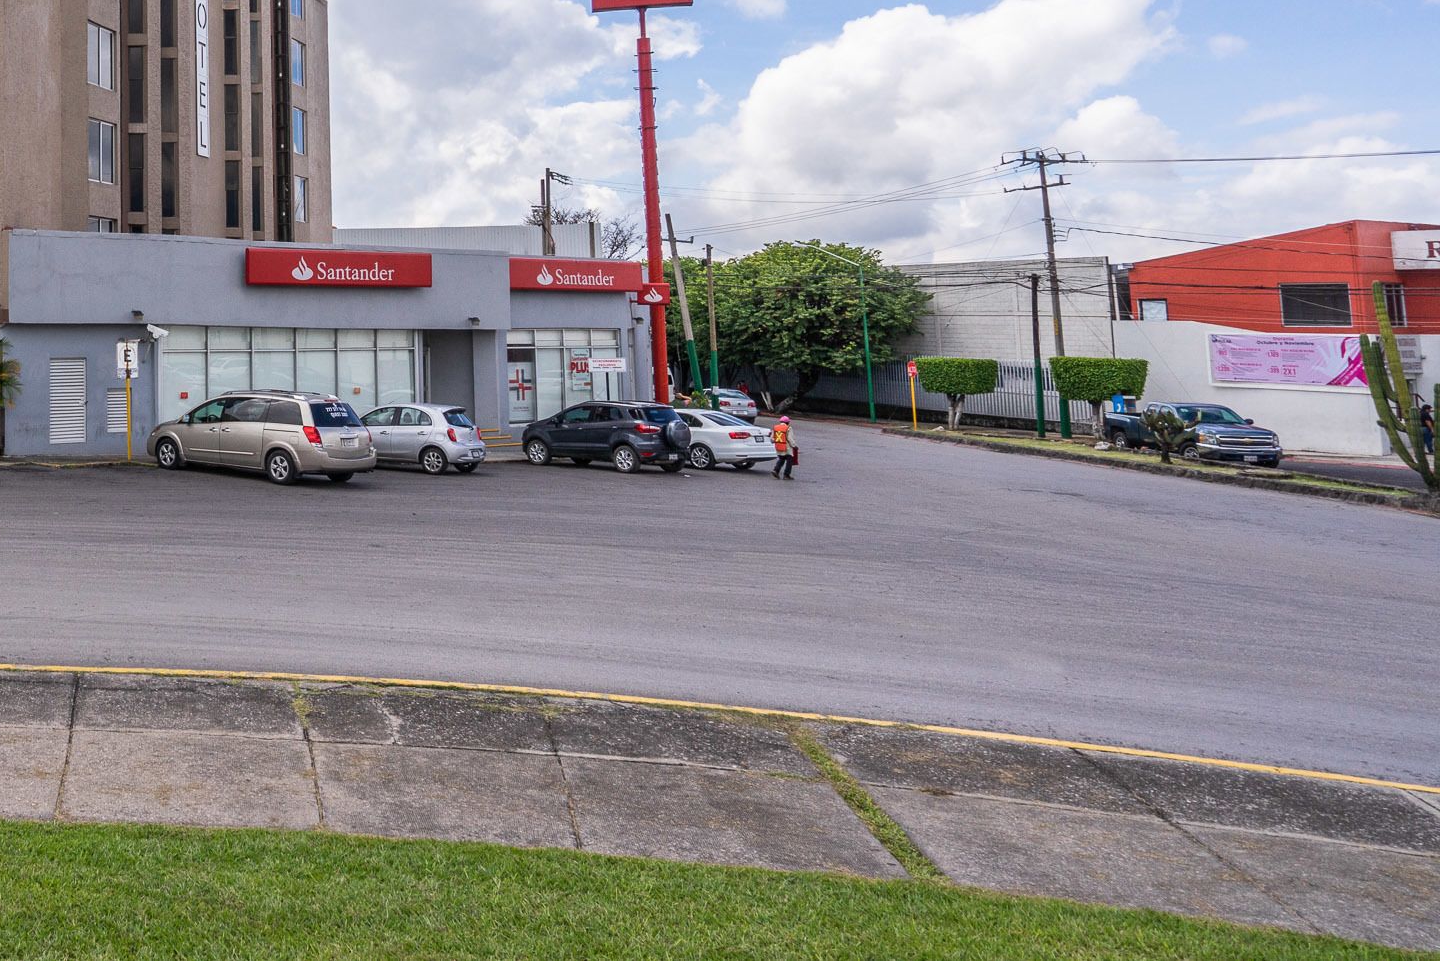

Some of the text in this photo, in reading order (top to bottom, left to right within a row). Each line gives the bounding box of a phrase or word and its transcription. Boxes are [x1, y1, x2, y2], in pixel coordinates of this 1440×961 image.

[317, 261, 395, 281] Santander
[556, 269, 614, 286] Santander
[123, 349, 132, 362] E
